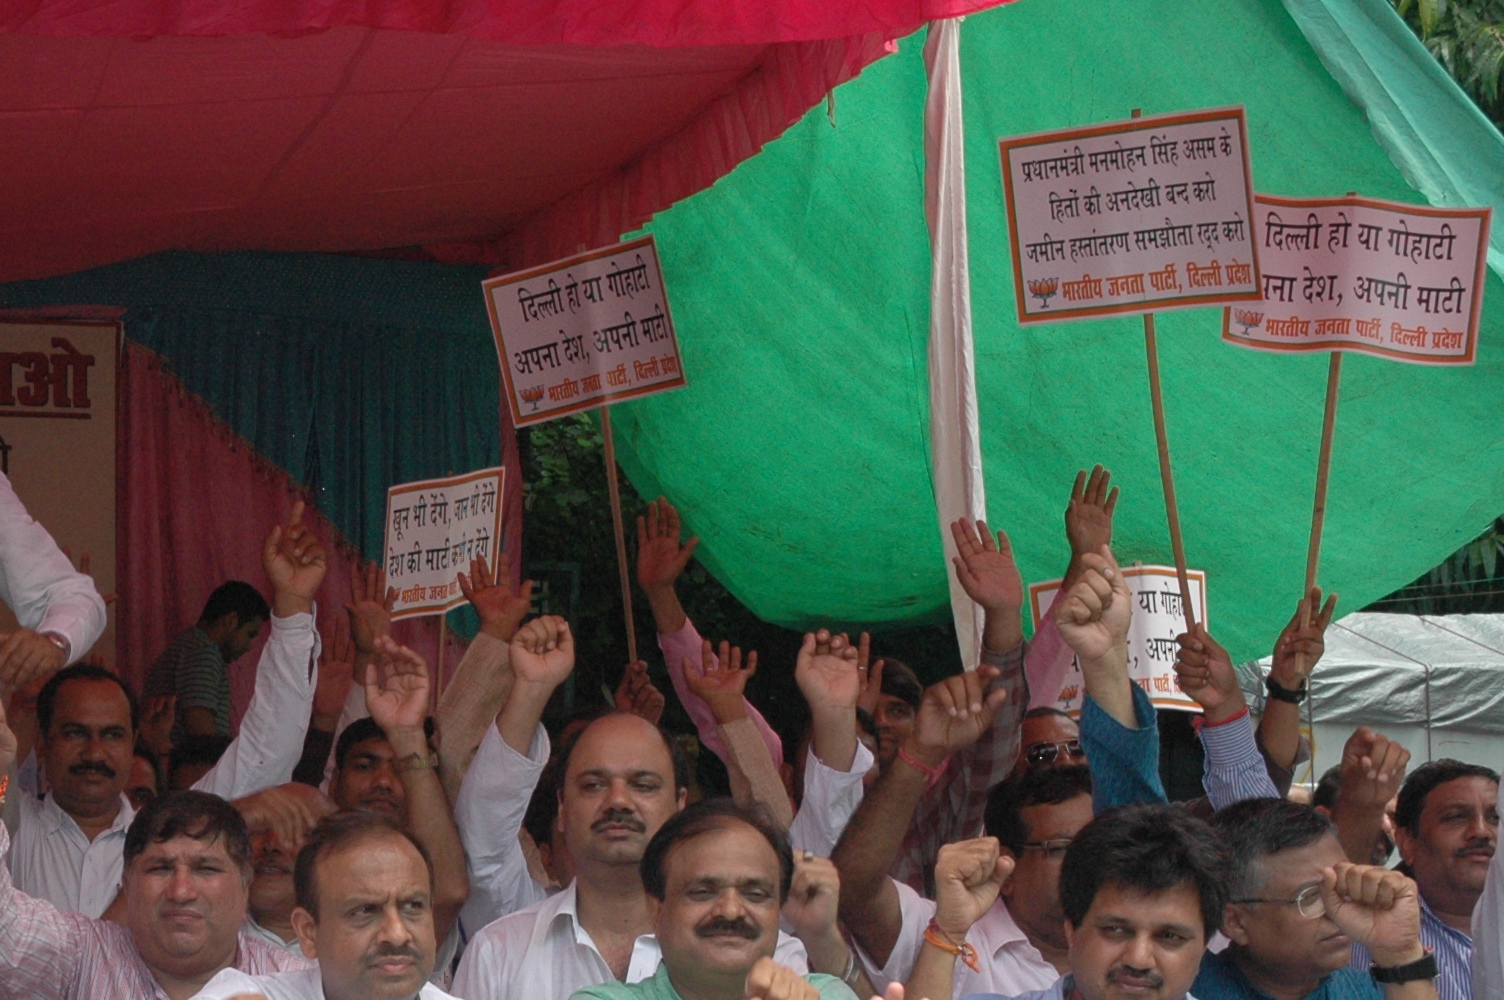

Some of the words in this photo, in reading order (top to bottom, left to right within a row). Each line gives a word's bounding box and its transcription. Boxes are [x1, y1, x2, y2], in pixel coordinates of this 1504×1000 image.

[1021, 146, 1085, 182] प्रधानमंत्री
[1088, 141, 1146, 172] मनमोहन
[1150, 135, 1178, 166] सिंह
[1183, 136, 1215, 161] असम
[1220, 127, 1231, 157] के
[1049, 189, 1080, 223] हितों
[1084, 186, 1101, 215] की
[1106, 178, 1161, 212] अनदेखी
[1165, 182, 1188, 204] बन्द
[1193, 172, 1216, 201] करो
[1026, 233, 1065, 263] जमीन
[1069, 229, 1130, 263] हस्तांतरण
[1134, 217, 1194, 250] समझौता
[1222, 212, 1245, 242] करो
[1266, 212, 1322, 251] दिल्ली
[1329, 213, 1352, 254] हो
[1358, 223, 1383, 252] या
[1388, 219, 1456, 264] गोहाटी
[518, 279, 564, 322] दिल्ली
[565, 273, 581, 314] हो
[582, 276, 604, 303] या
[606, 254, 650, 299] गोहाटी
[1062, 274, 1102, 301] भारतीय
[1106, 273, 1144, 296] जनता
[1149, 263, 1183, 293] पार्टी,
[1186, 260, 1222, 288] दिल्ली
[1225, 258, 1252, 286] प्रदेश
[1303, 267, 1342, 307] देश,
[1354, 272, 1411, 311] अपनी
[1417, 277, 1466, 313] माटी
[515, 342, 561, 374] अपना
[562, 330, 589, 364] देश,
[594, 312, 639, 353] अपनी
[640, 304, 668, 343] माटी
[1266, 317, 1310, 337] भारतीय
[1315, 318, 1351, 335] जनता
[1356, 318, 1384, 344] पार्टी,
[1390, 323, 1428, 348] दिल्ली
[1432, 327, 1463, 349] प्रदेश
[549, 378, 579, 402] भारतीय
[581, 374, 600, 394] जनता
[607, 364, 632, 387] पार्टी,
[634, 356, 660, 381] दिल्ली
[393, 507, 410, 541] खून
[413, 494, 427, 527] भी
[431, 493, 451, 529] देंगे,
[454, 497, 469, 521] जान
[471, 484, 480, 516] भी
[481, 482, 495, 516] देंगे
[389, 547, 405, 578] देश
[407, 541, 422, 574] की
[426, 538, 450, 571] माटी
[451, 533, 466, 567] कभी
[468, 539, 473, 560] न
[475, 527, 490, 558] देंगे
[402, 584, 426, 603] भारतीय
[1138, 590, 1158, 613] या
